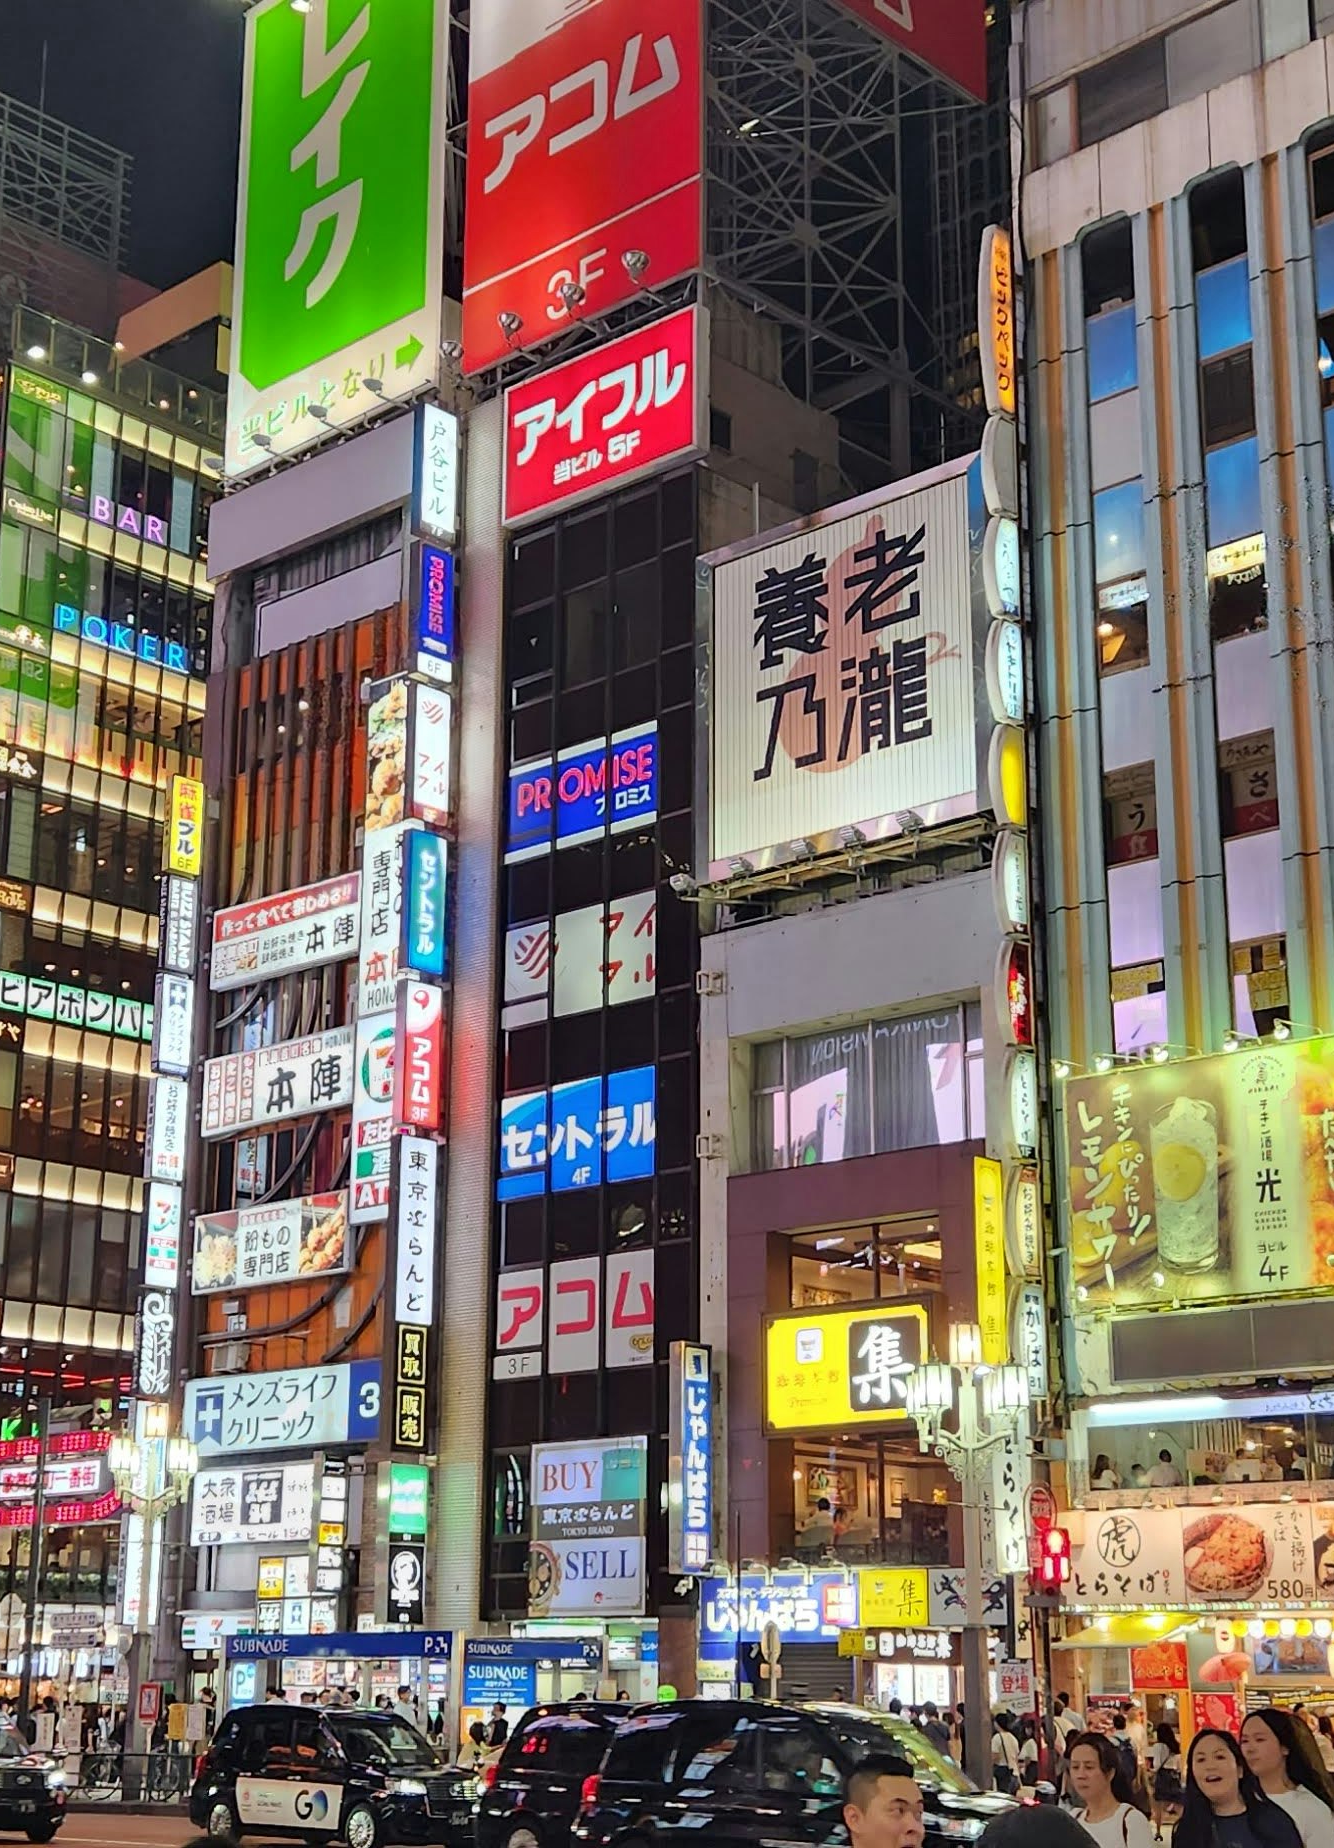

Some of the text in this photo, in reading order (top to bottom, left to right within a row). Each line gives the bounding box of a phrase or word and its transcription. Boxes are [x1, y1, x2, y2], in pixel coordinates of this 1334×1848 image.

[485, 33, 680, 194] アコム
[284, 0, 371, 309] レイク
[546, 248, 607, 321] 3F
[514, 348, 686, 466] アイフル
[430, 422, 449, 515] 戸谷ビル
[554, 429, 640, 484] 当ビル 5F
[94, 495, 164, 544] BAR
[429, 556, 444, 635] PROMISE
[754, 524, 925, 670] 養老
[56, 603, 188, 671] POKER
[428, 659, 441, 674] 6F
[753, 637, 932, 781] 乃瀧
[517, 744, 652, 816] PROMISE
[595, 784, 650, 815] プロミス
[1129, 802, 1145, 830] う
[178, 857, 192, 869] 6F
[416, 851, 437, 954] セントラル
[178, 919, 192, 969] STAND
[306, 913, 355, 954] 本陣
[366, 948, 399, 985] 本
[266, 1054, 341, 1114] 本陣
[411, 1038, 432, 1102] アコム
[411, 1107, 429, 1120] 3F
[1260, 1100, 1273, 1161] チキン酒場
[501, 1102, 656, 1168] セントラル
[572, 1168, 590, 1184] 4F
[1255, 1168, 1282, 1203] 光
[1077, 1101, 1116, 1291] レモンサワー
[244, 1226, 290, 1252] 粉もの
[243, 1252, 289, 1278] 専門店
[1259, 1255, 1289, 1283] 4F
[500, 1272, 654, 1344] アコム
[404, 1334, 421, 1377] 買取
[508, 1356, 529, 1375] 3F
[852, 1325, 915, 1404] 集
[229, 1374, 338, 1409] メンズライフ
[359, 1382, 380, 1418] 3
[228, 1411, 315, 1446] クリニック
[402, 1395, 420, 1440] 販売
[202, 1477, 236, 1500] 大衆
[542, 1461, 598, 1492] BUY
[201, 1502, 234, 1524] 酒場
[562, 1525, 614, 1537] TOKYO BRAND
[1274, 1510, 1286, 1542] そば
[1102, 1517, 1137, 1564] 虎
[1289, 1509, 1307, 1573] かき揚げ
[565, 1549, 637, 1580] SELL
[1076, 1569, 1160, 1596] とらそば
[896, 1578, 924, 1618] 集
[1267, 1579, 1314, 1599] 580円
[232, 1639, 290, 1656] SUBNADE
[468, 1642, 513, 1656] SUBNADE
[468, 1665, 528, 1682] SUBNADE
[1001, 1675, 1030, 1694] 登場
[294, 1789, 328, 1821] GO
